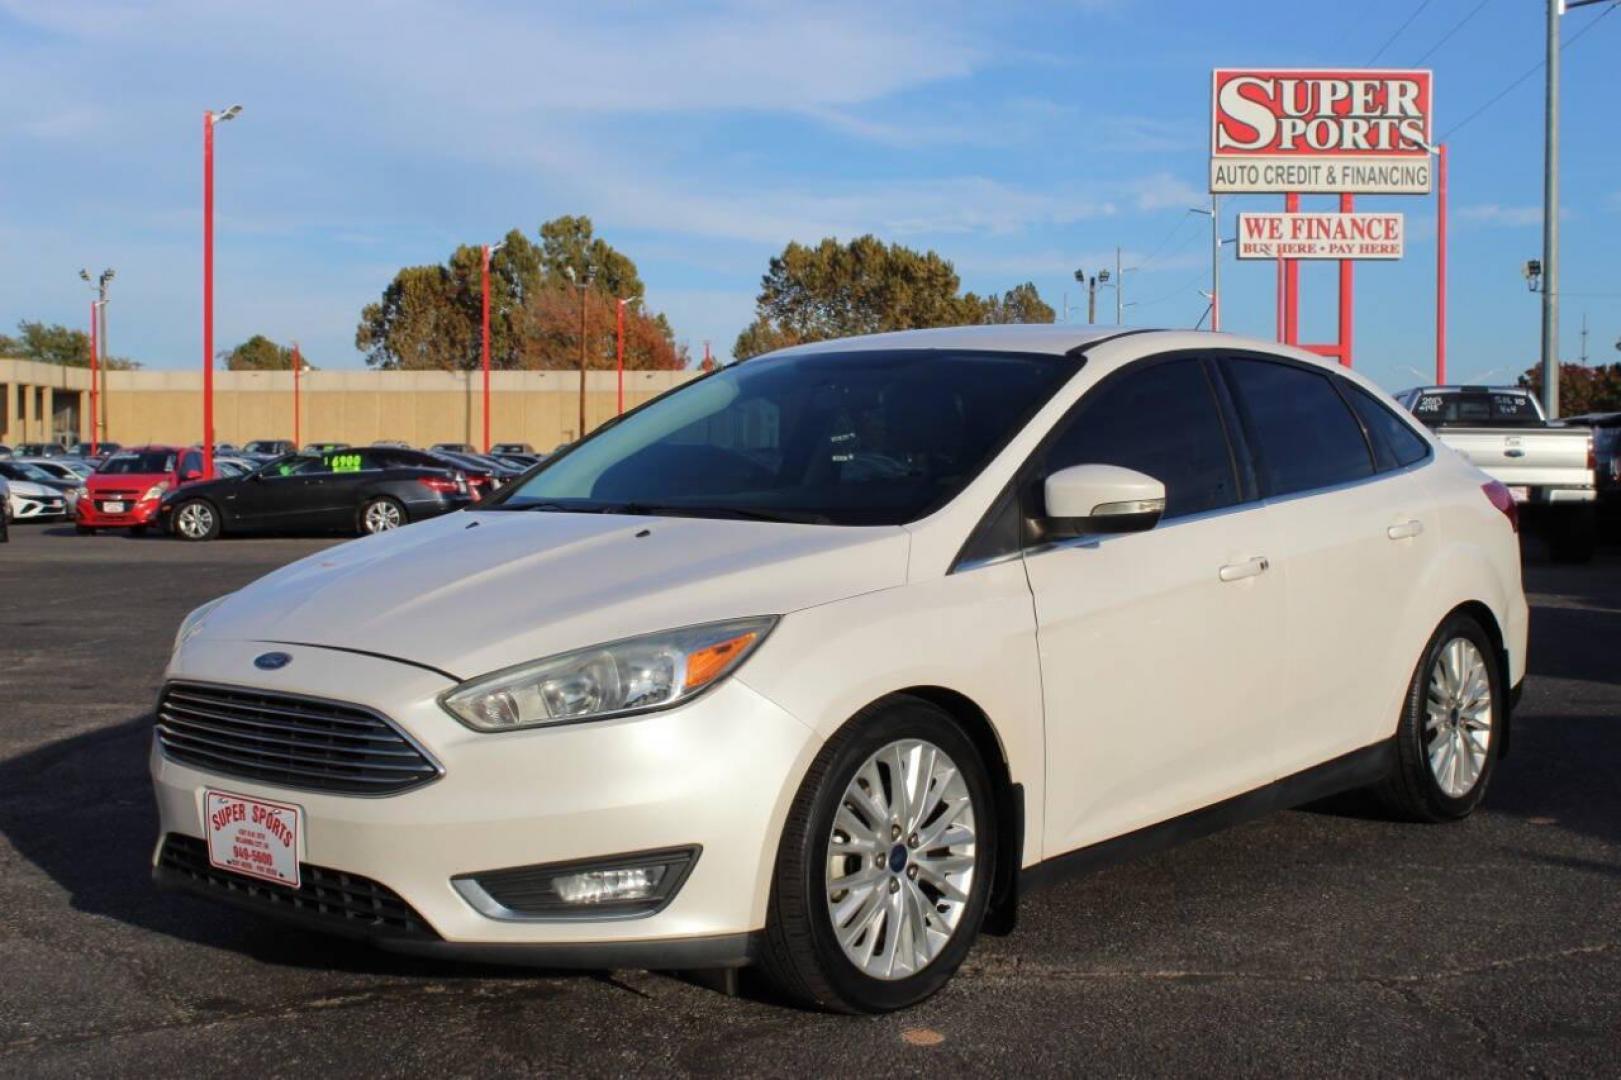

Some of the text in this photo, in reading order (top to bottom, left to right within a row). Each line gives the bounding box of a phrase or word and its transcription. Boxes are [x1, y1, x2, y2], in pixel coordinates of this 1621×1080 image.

[1219, 77, 1423, 150] SUPER
[1215, 165, 1428, 186] AUTO CREDIT & FINANCING
[1244, 217, 1399, 240] WE FINANCE
[1277, 243, 1317, 254] HERE
[1329, 243, 1355, 254] PAY
[1359, 243, 1400, 254] HERE
[212, 804, 293, 848] SUPER SPORTS
